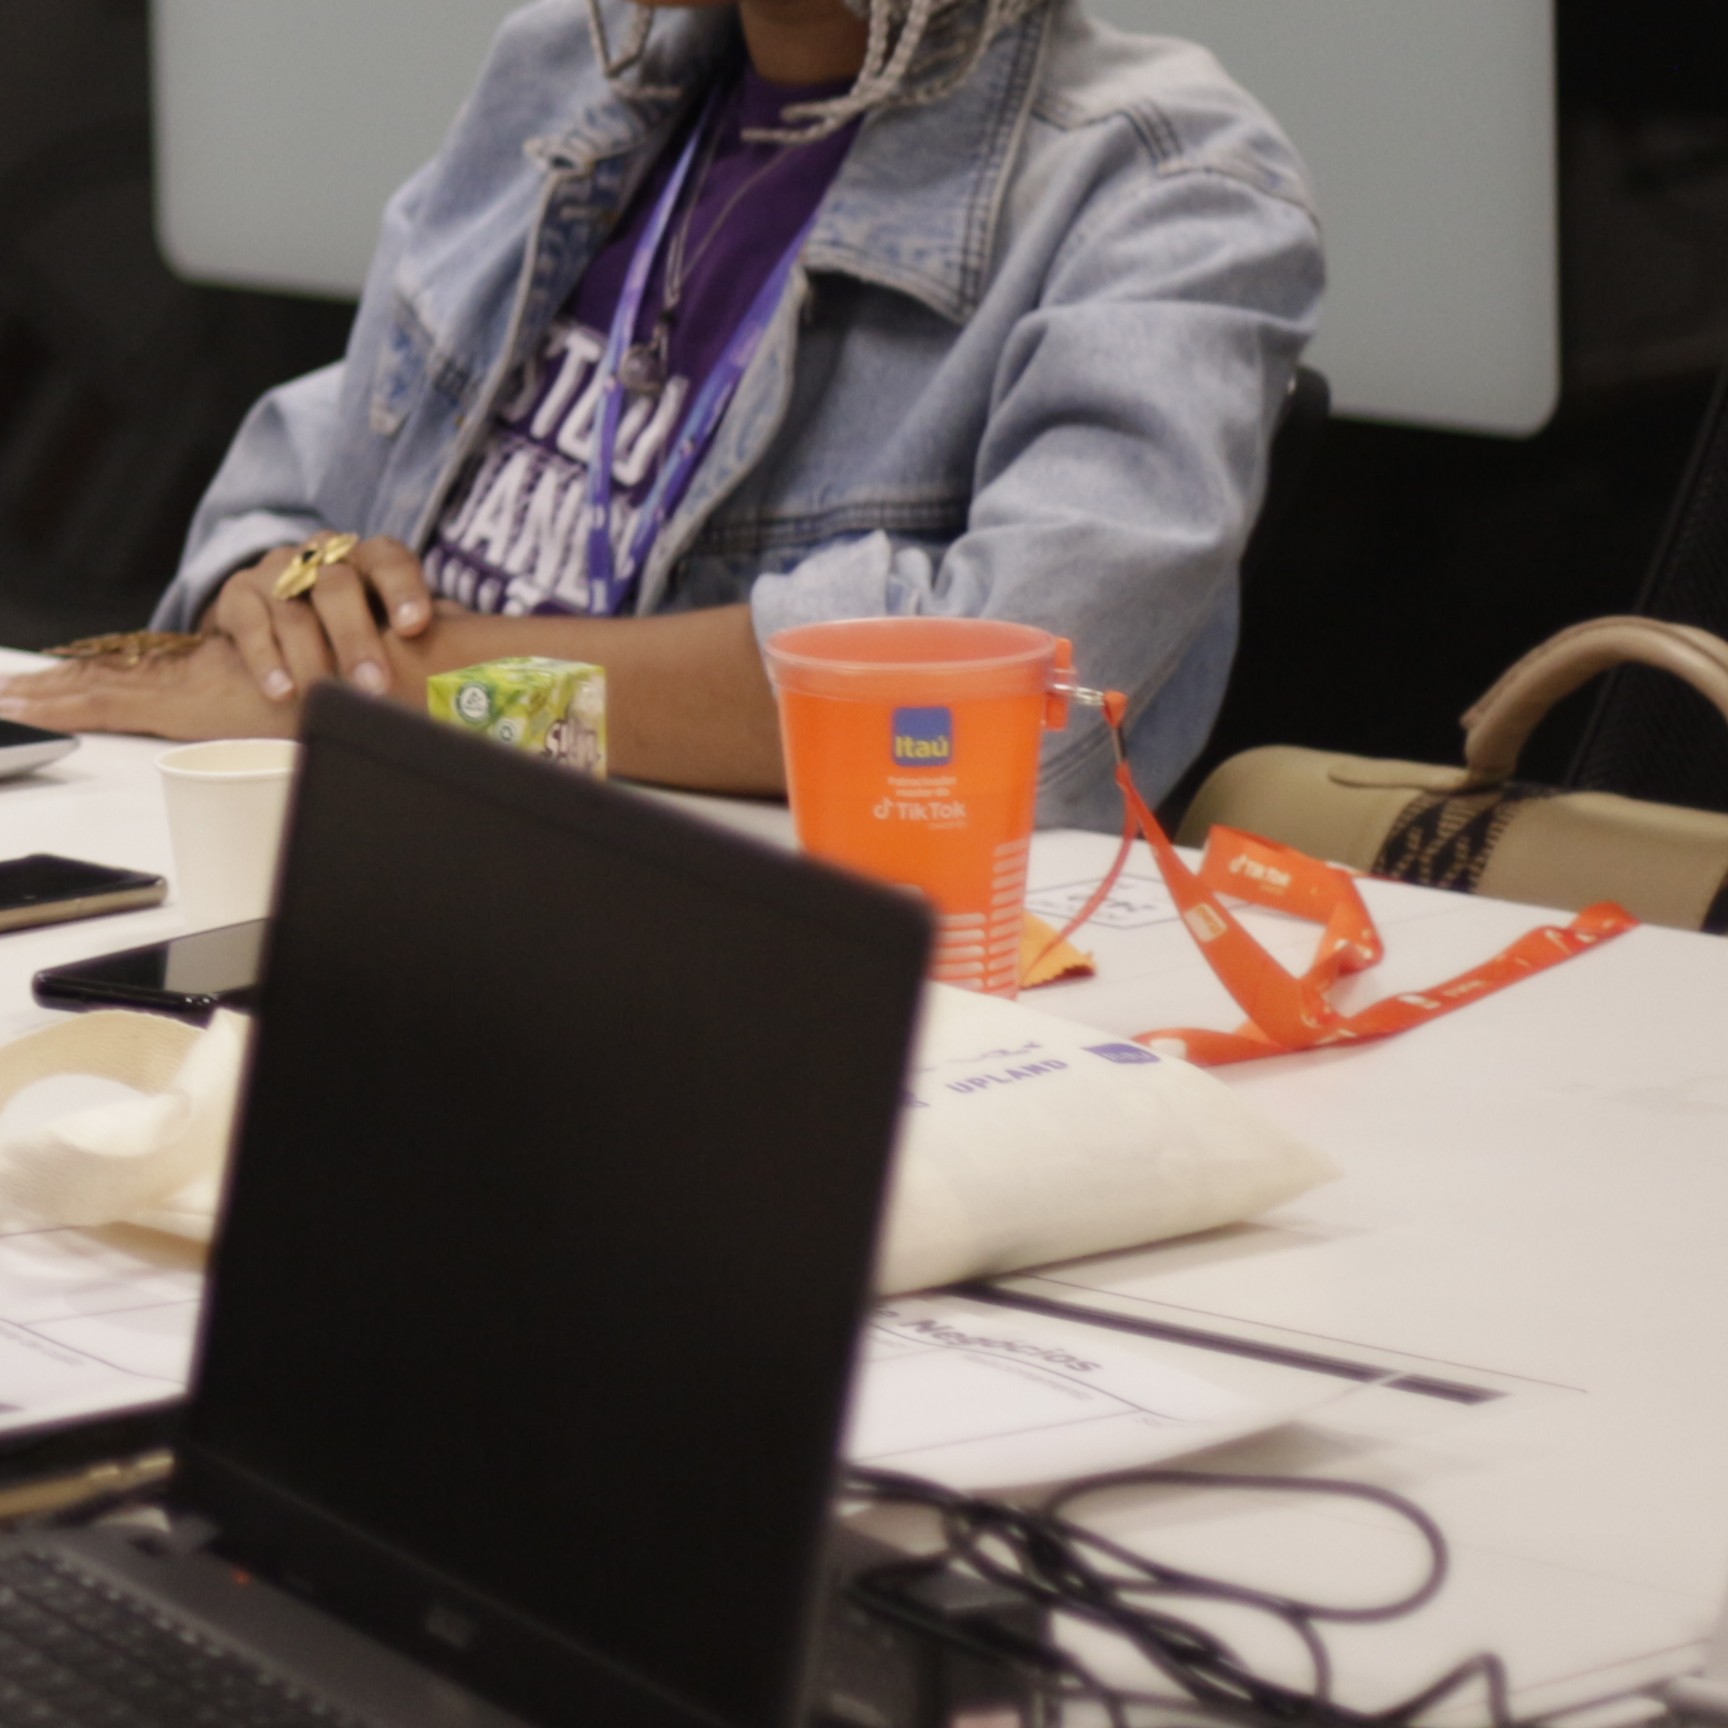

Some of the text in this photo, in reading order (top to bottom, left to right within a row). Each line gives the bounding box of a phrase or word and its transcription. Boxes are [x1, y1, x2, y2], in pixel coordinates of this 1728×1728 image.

[894, 734, 949, 758] Itaú
[896, 801, 966, 821] TikTok
[944, 1059, 1070, 1094] UPLAND
